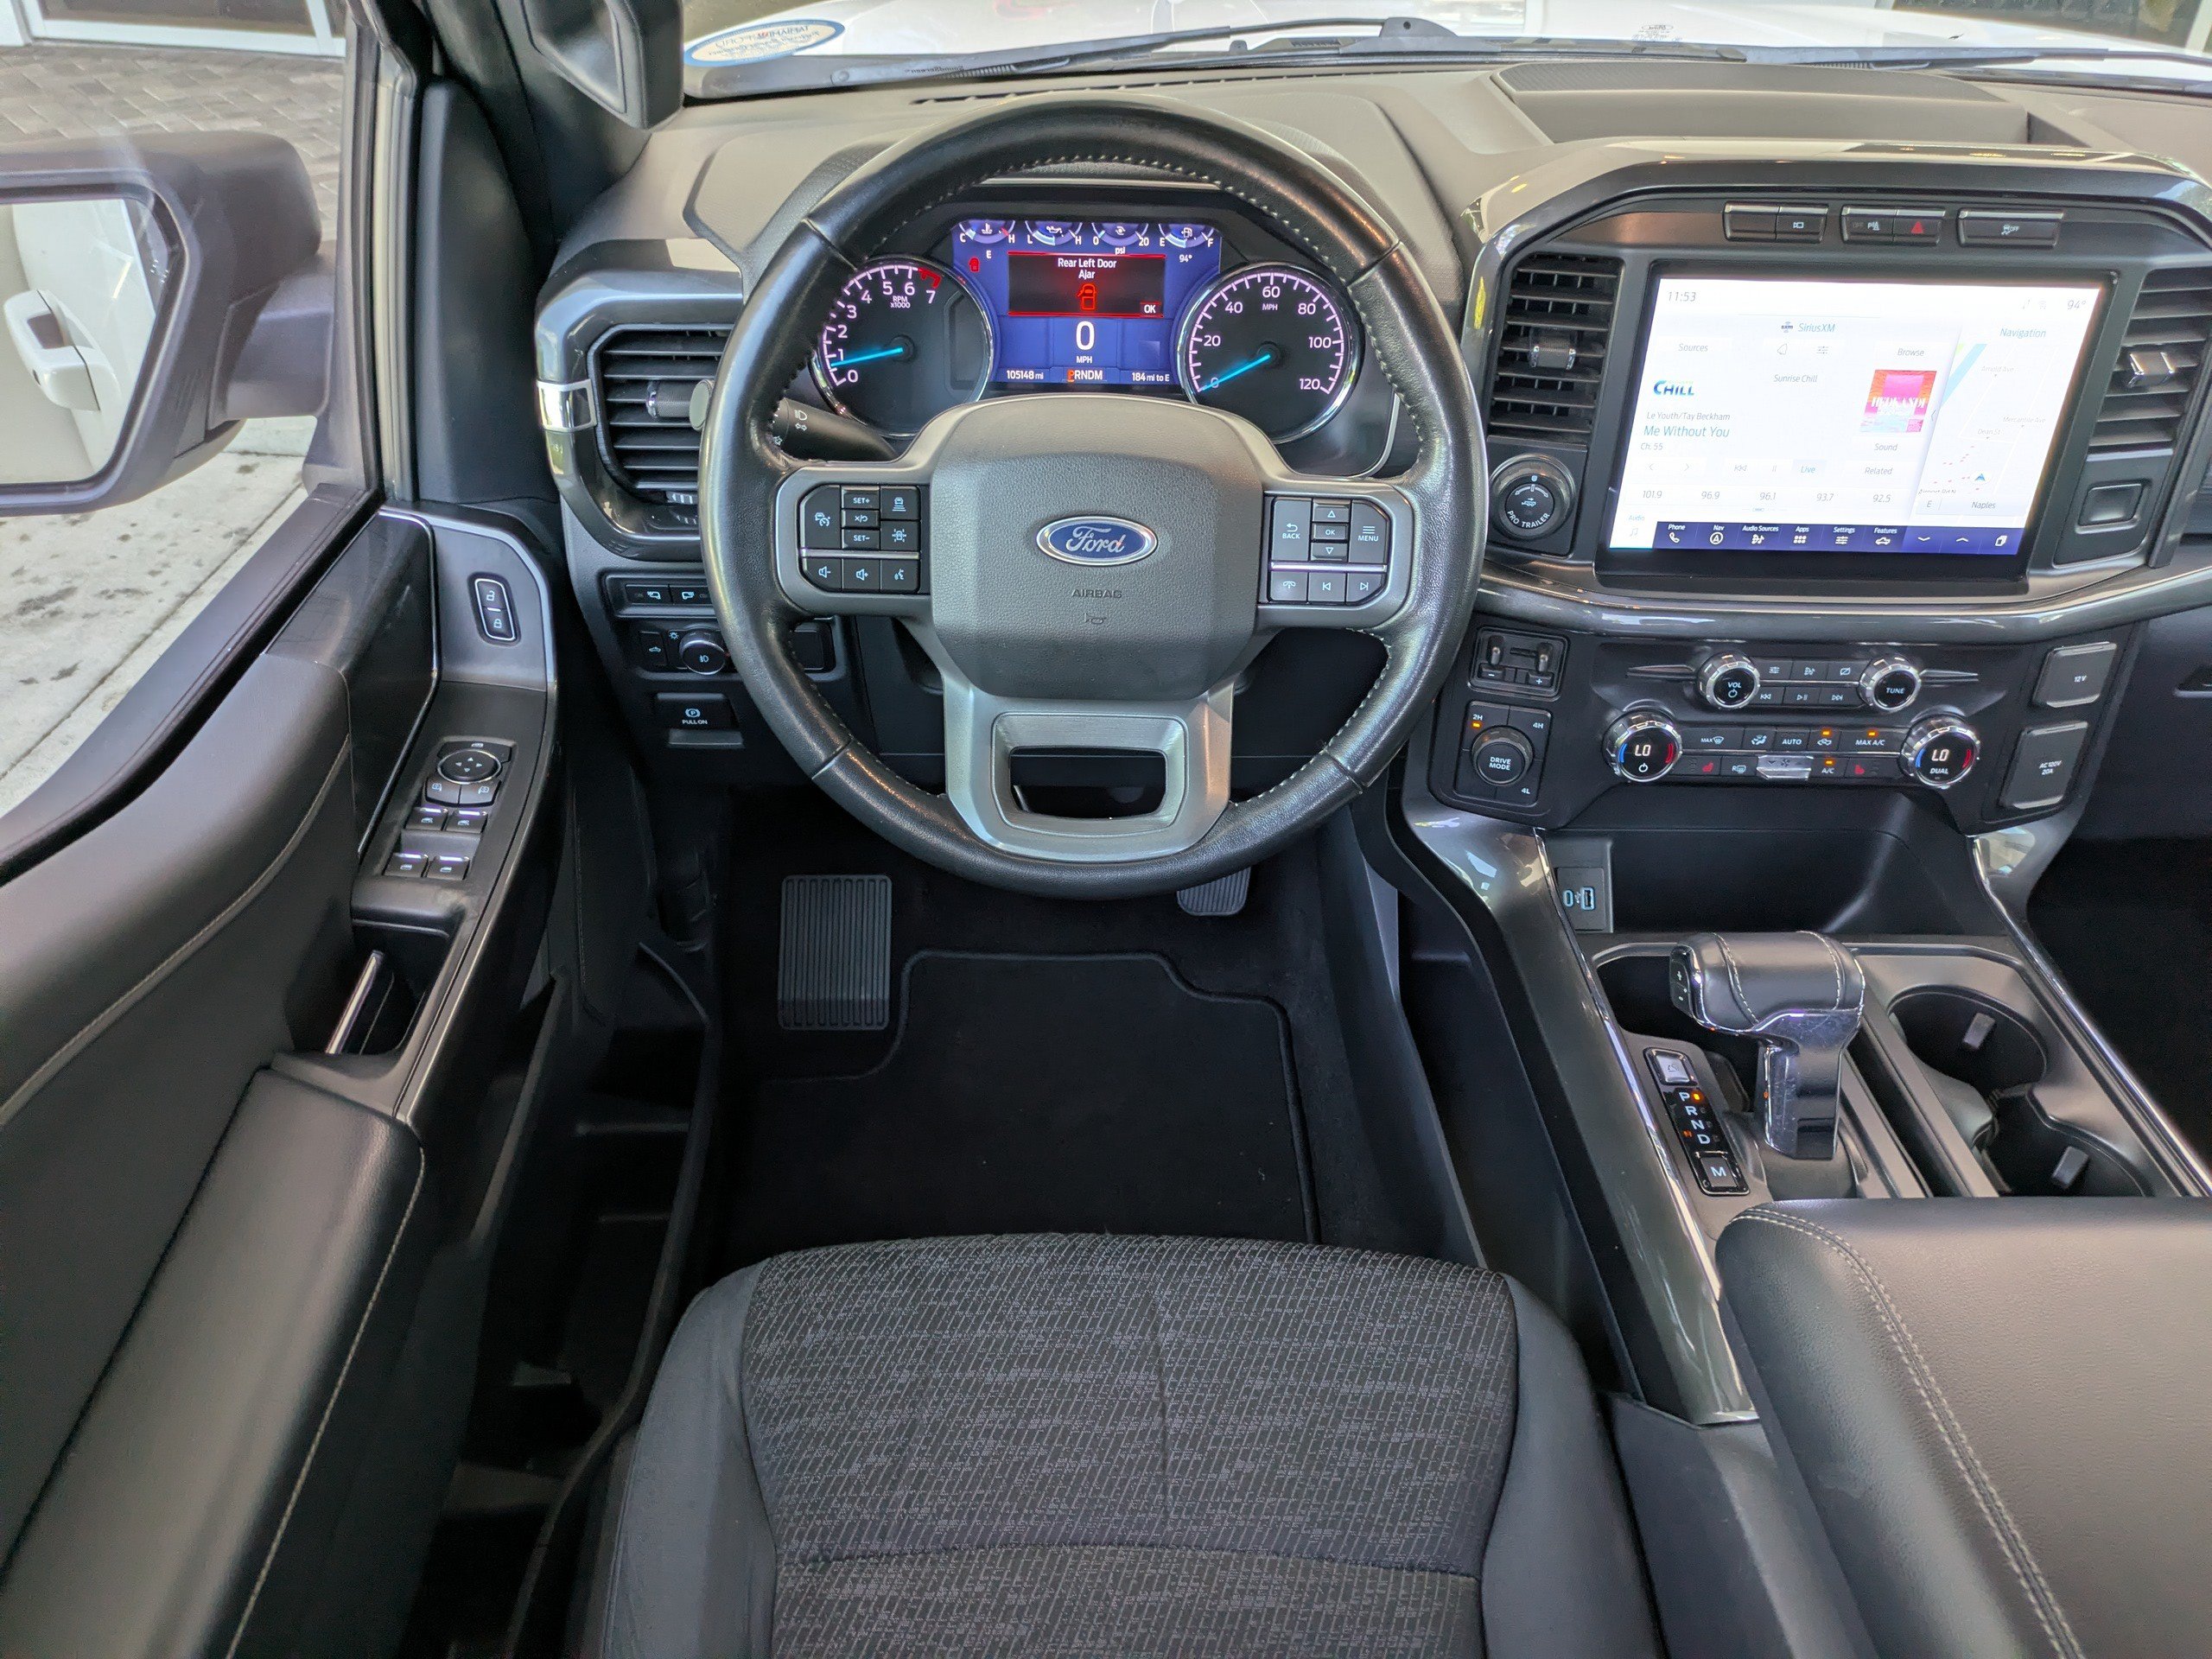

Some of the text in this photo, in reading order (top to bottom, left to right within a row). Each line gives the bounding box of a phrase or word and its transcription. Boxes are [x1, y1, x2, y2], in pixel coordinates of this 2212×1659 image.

[959, 233, 966, 243] C
[1008, 234, 1015, 244] H
[1027, 235, 1033, 245] L
[1074, 236, 1082, 245] H
[1092, 236, 1099, 245] 0
[1138, 236, 1150, 246] 20
[1159, 238, 1166, 247] E
[1207, 238, 1214, 247] F
[985, 249, 992, 259] E
[1115, 246, 1126, 256] psi
[1058, 257, 1117, 269] Rear Left Door
[1077, 270, 1096, 280] Ajar
[882, 281, 893, 296] 5
[904, 282, 916, 296] 6
[1262, 285, 1281, 298] 60
[861, 289, 873, 304] 4
[925, 289, 937, 304] 7
[1668, 291, 1696, 302] 11:53
[846, 304, 858, 319] 3
[1143, 304, 1156, 314] OK
[1224, 302, 1243, 314] 40
[1298, 302, 1316, 315] 80
[837, 324, 849, 339] 2
[1797, 322, 1836, 333] SiriusXM
[1999, 327, 2047, 339] Navigation
[1076, 320, 1096, 351] 0
[1204, 334, 1221, 347] 20
[1308, 336, 1332, 349] 100
[1678, 342, 1708, 352] Sources
[837, 348, 844, 361] 1
[1897, 347, 1925, 357] Browse
[1076, 355, 1093, 364] MPH
[847, 369, 859, 383] 0
[1006, 369, 1044, 380] 105148 mi
[1132, 372, 1146, 382] 184
[1147, 373, 1155, 382] mi
[1774, 373, 1818, 383] Sunrise Chill
[1299, 378, 1321, 390] 120
[1646, 411, 1731, 422] Le Youth/Tay Beckham
[1643, 424, 1730, 438] Me Without You
[1640, 442, 1663, 451] Ch. 55
[1873, 442, 1898, 452] Sound
[1801, 465, 1815, 474] Live
[1864, 467, 1893, 475] Related
[1642, 490, 1662, 499] 101.9
[1700, 491, 1720, 500] 96.9
[1759, 492, 1777, 501] 96.1
[1816, 493, 1834, 502] 93.7
[1872, 493, 1891, 504] 92.5
[1971, 501, 1996, 510] Naples
[1507, 510, 1551, 529] PRO TRAILER
[1065, 525, 1125, 553] Ford
[1071, 588, 1122, 599] AIRBAG
[1634, 744, 1651, 757] LO
[1930, 748, 1950, 762] LO
[1490, 756, 1511, 765] DRIVE
[1489, 762, 1511, 771] MODE
[1678, 1091, 1691, 1102] P
[1685, 1106, 1698, 1116] R
[1690, 1119, 1706, 1130] N
[1697, 1134, 1711, 1145] D
[1711, 1166, 1726, 1177] M
